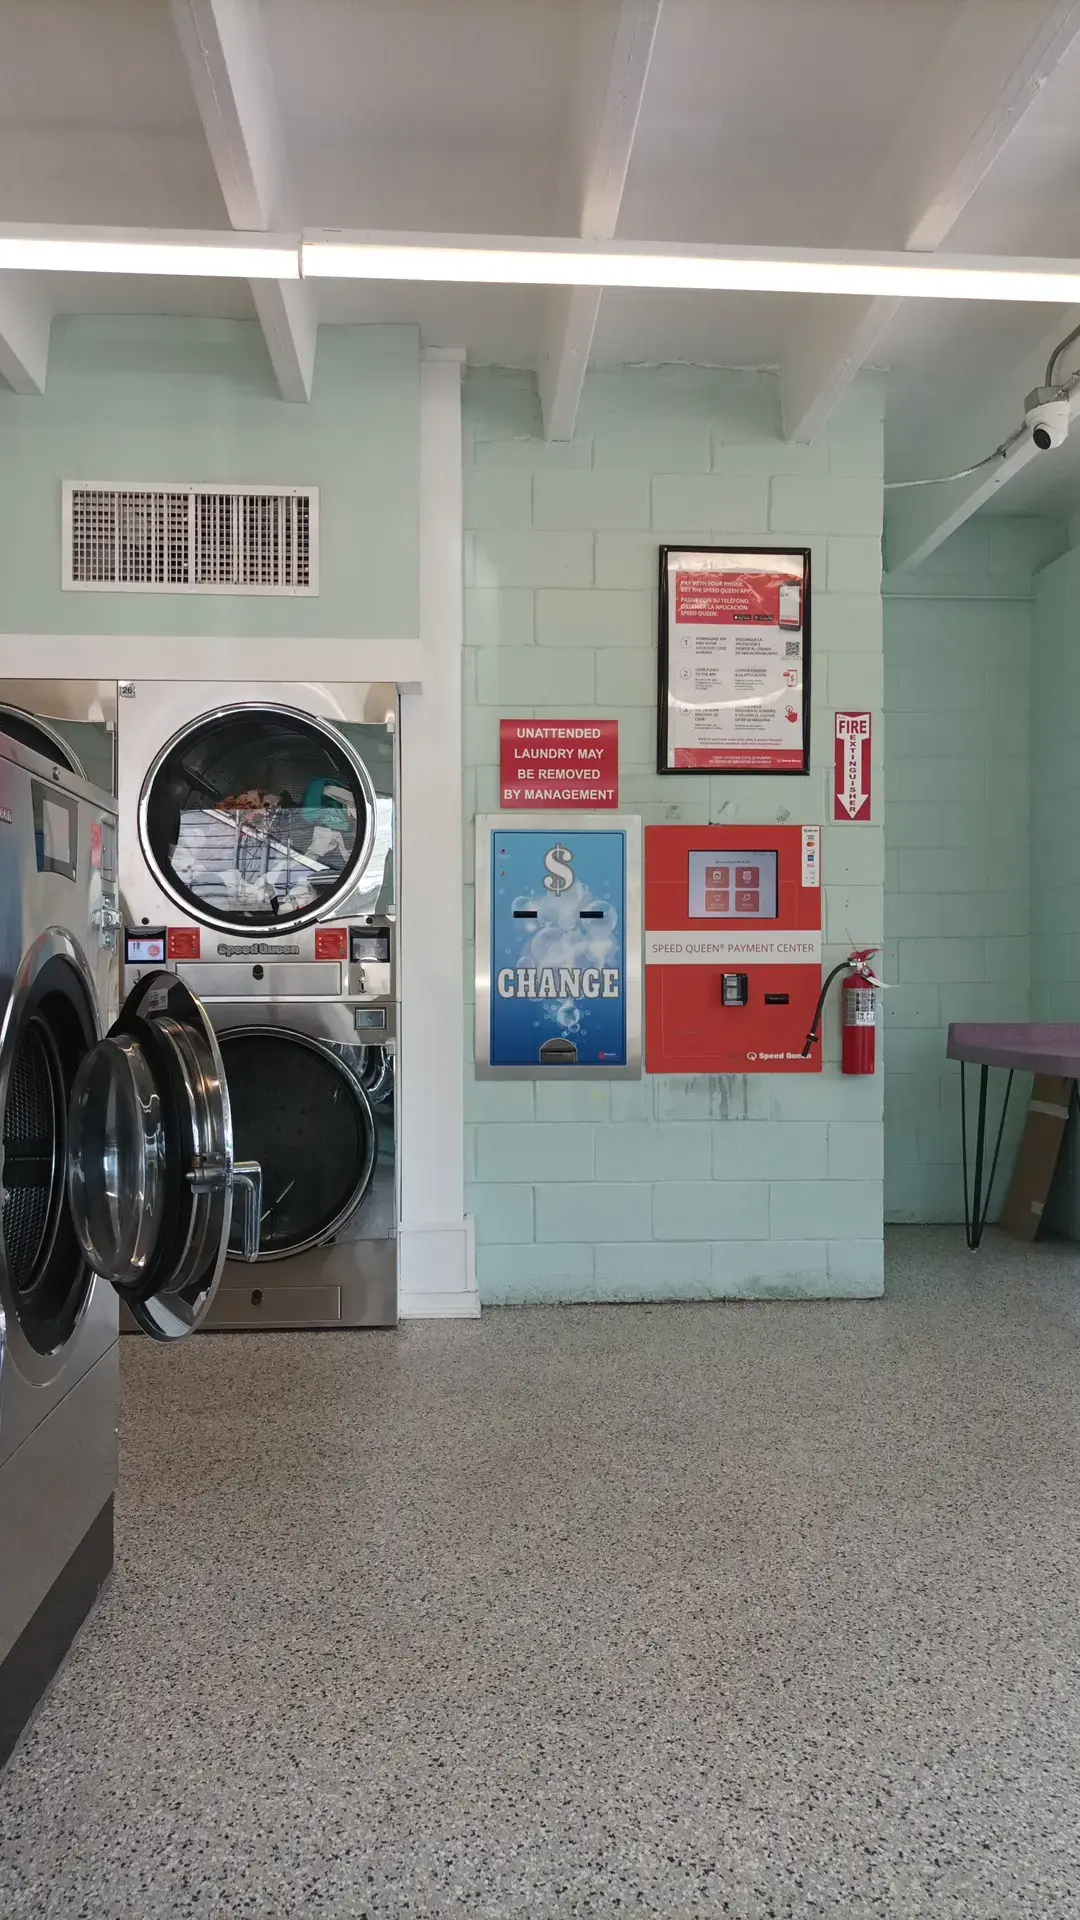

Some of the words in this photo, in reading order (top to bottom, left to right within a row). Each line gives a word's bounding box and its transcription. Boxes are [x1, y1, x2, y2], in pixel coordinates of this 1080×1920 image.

[122, 686, 133, 694] 26
[839, 720, 867, 734] FIRE
[516, 728, 601, 739] UNATTENDED
[514, 748, 574, 759] LAUNDRY
[577, 748, 604, 759] MAY
[517, 769, 535, 780] BE
[538, 769, 601, 780] REMOVED
[849, 735, 857, 812] EXTINGUISHER
[504, 789, 521, 800] BY
[524, 789, 615, 800] MANAGEMENT
[217, 943, 258, 957] Speed
[258, 943, 300, 955] Queen
[652, 943, 683, 953] SPEED
[727, 943, 774, 953] PAYMENT
[776, 943, 815, 953] CENTER
[497, 967, 620, 999] CHANGE
[758, 1052, 785, 1060] Speed
